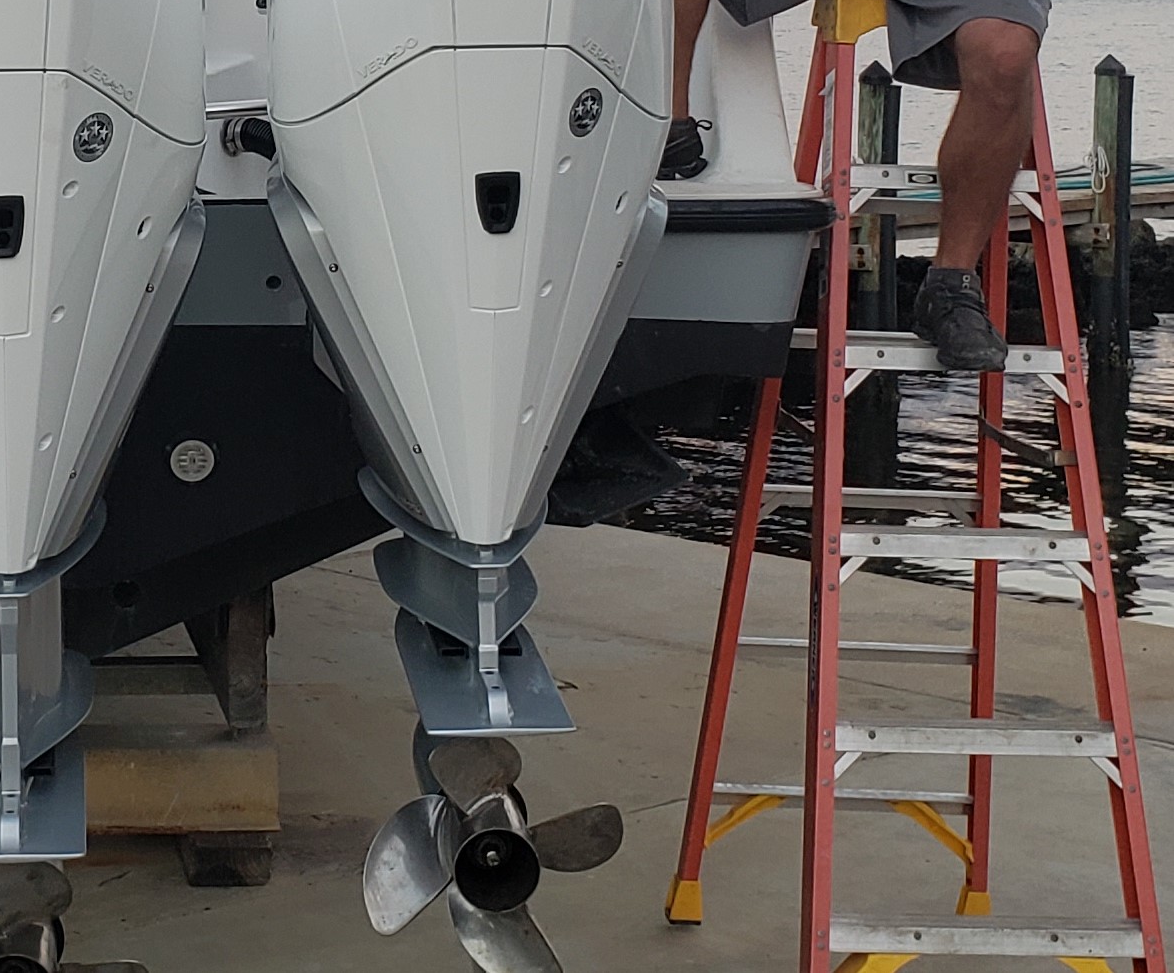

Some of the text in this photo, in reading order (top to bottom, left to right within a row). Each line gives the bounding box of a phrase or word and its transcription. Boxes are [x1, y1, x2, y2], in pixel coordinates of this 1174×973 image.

[356, 37, 419, 78] VERADO
[581, 37, 623, 77] VERADO
[83, 64, 134, 102] VERADO
